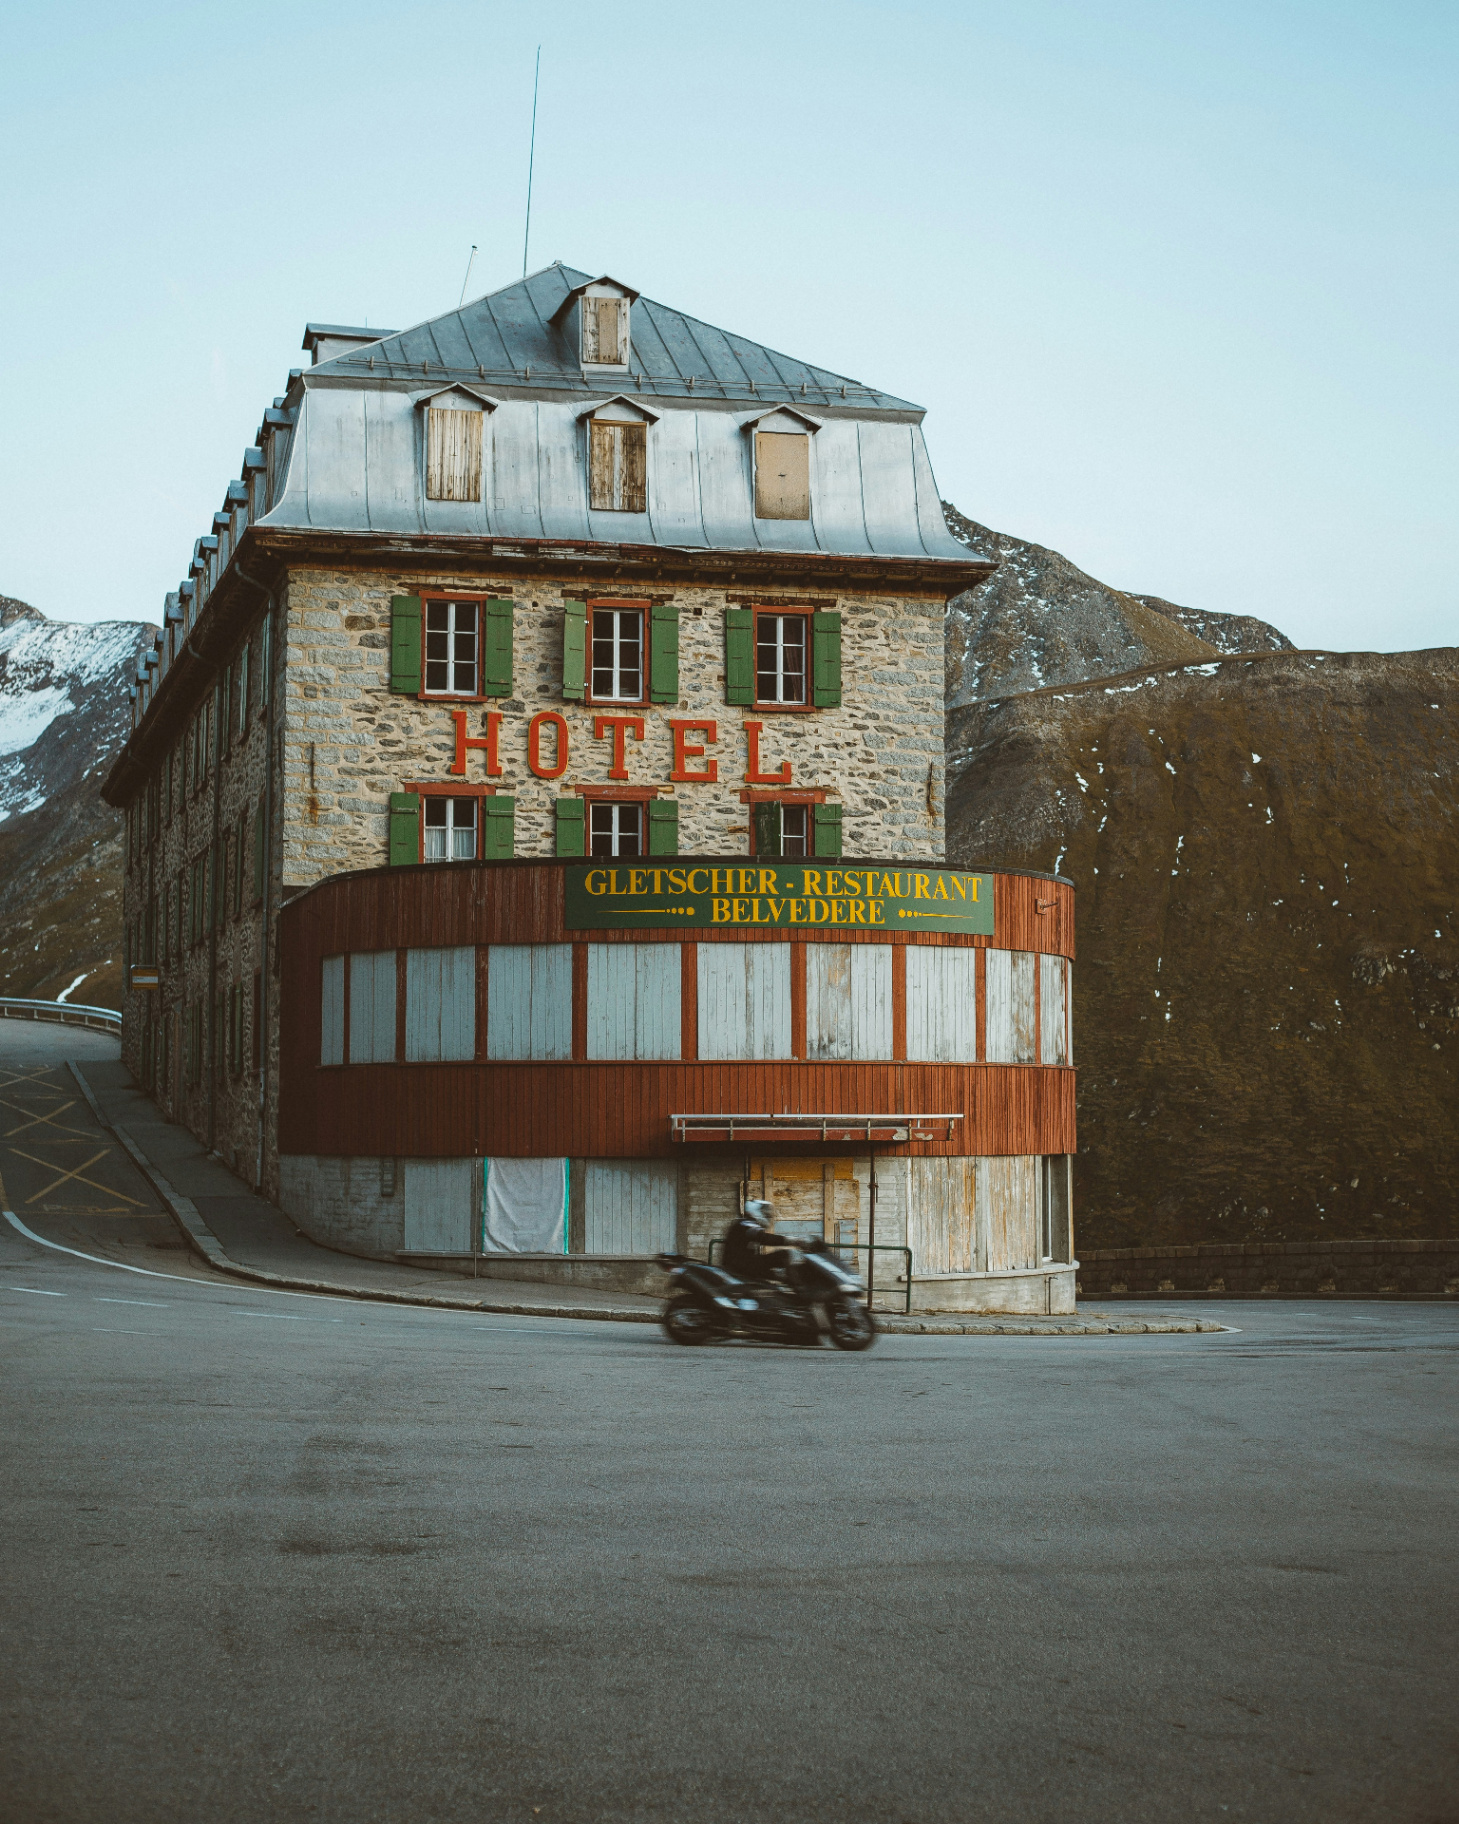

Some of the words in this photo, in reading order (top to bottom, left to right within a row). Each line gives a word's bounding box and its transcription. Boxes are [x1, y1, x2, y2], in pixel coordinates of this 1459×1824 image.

[450, 710, 792, 784] HOTEL
[584, 868, 780, 896] GLETSCHER
[801, 869, 983, 903] RESTAURANT
[709, 897, 886, 925] BELVEDERE
